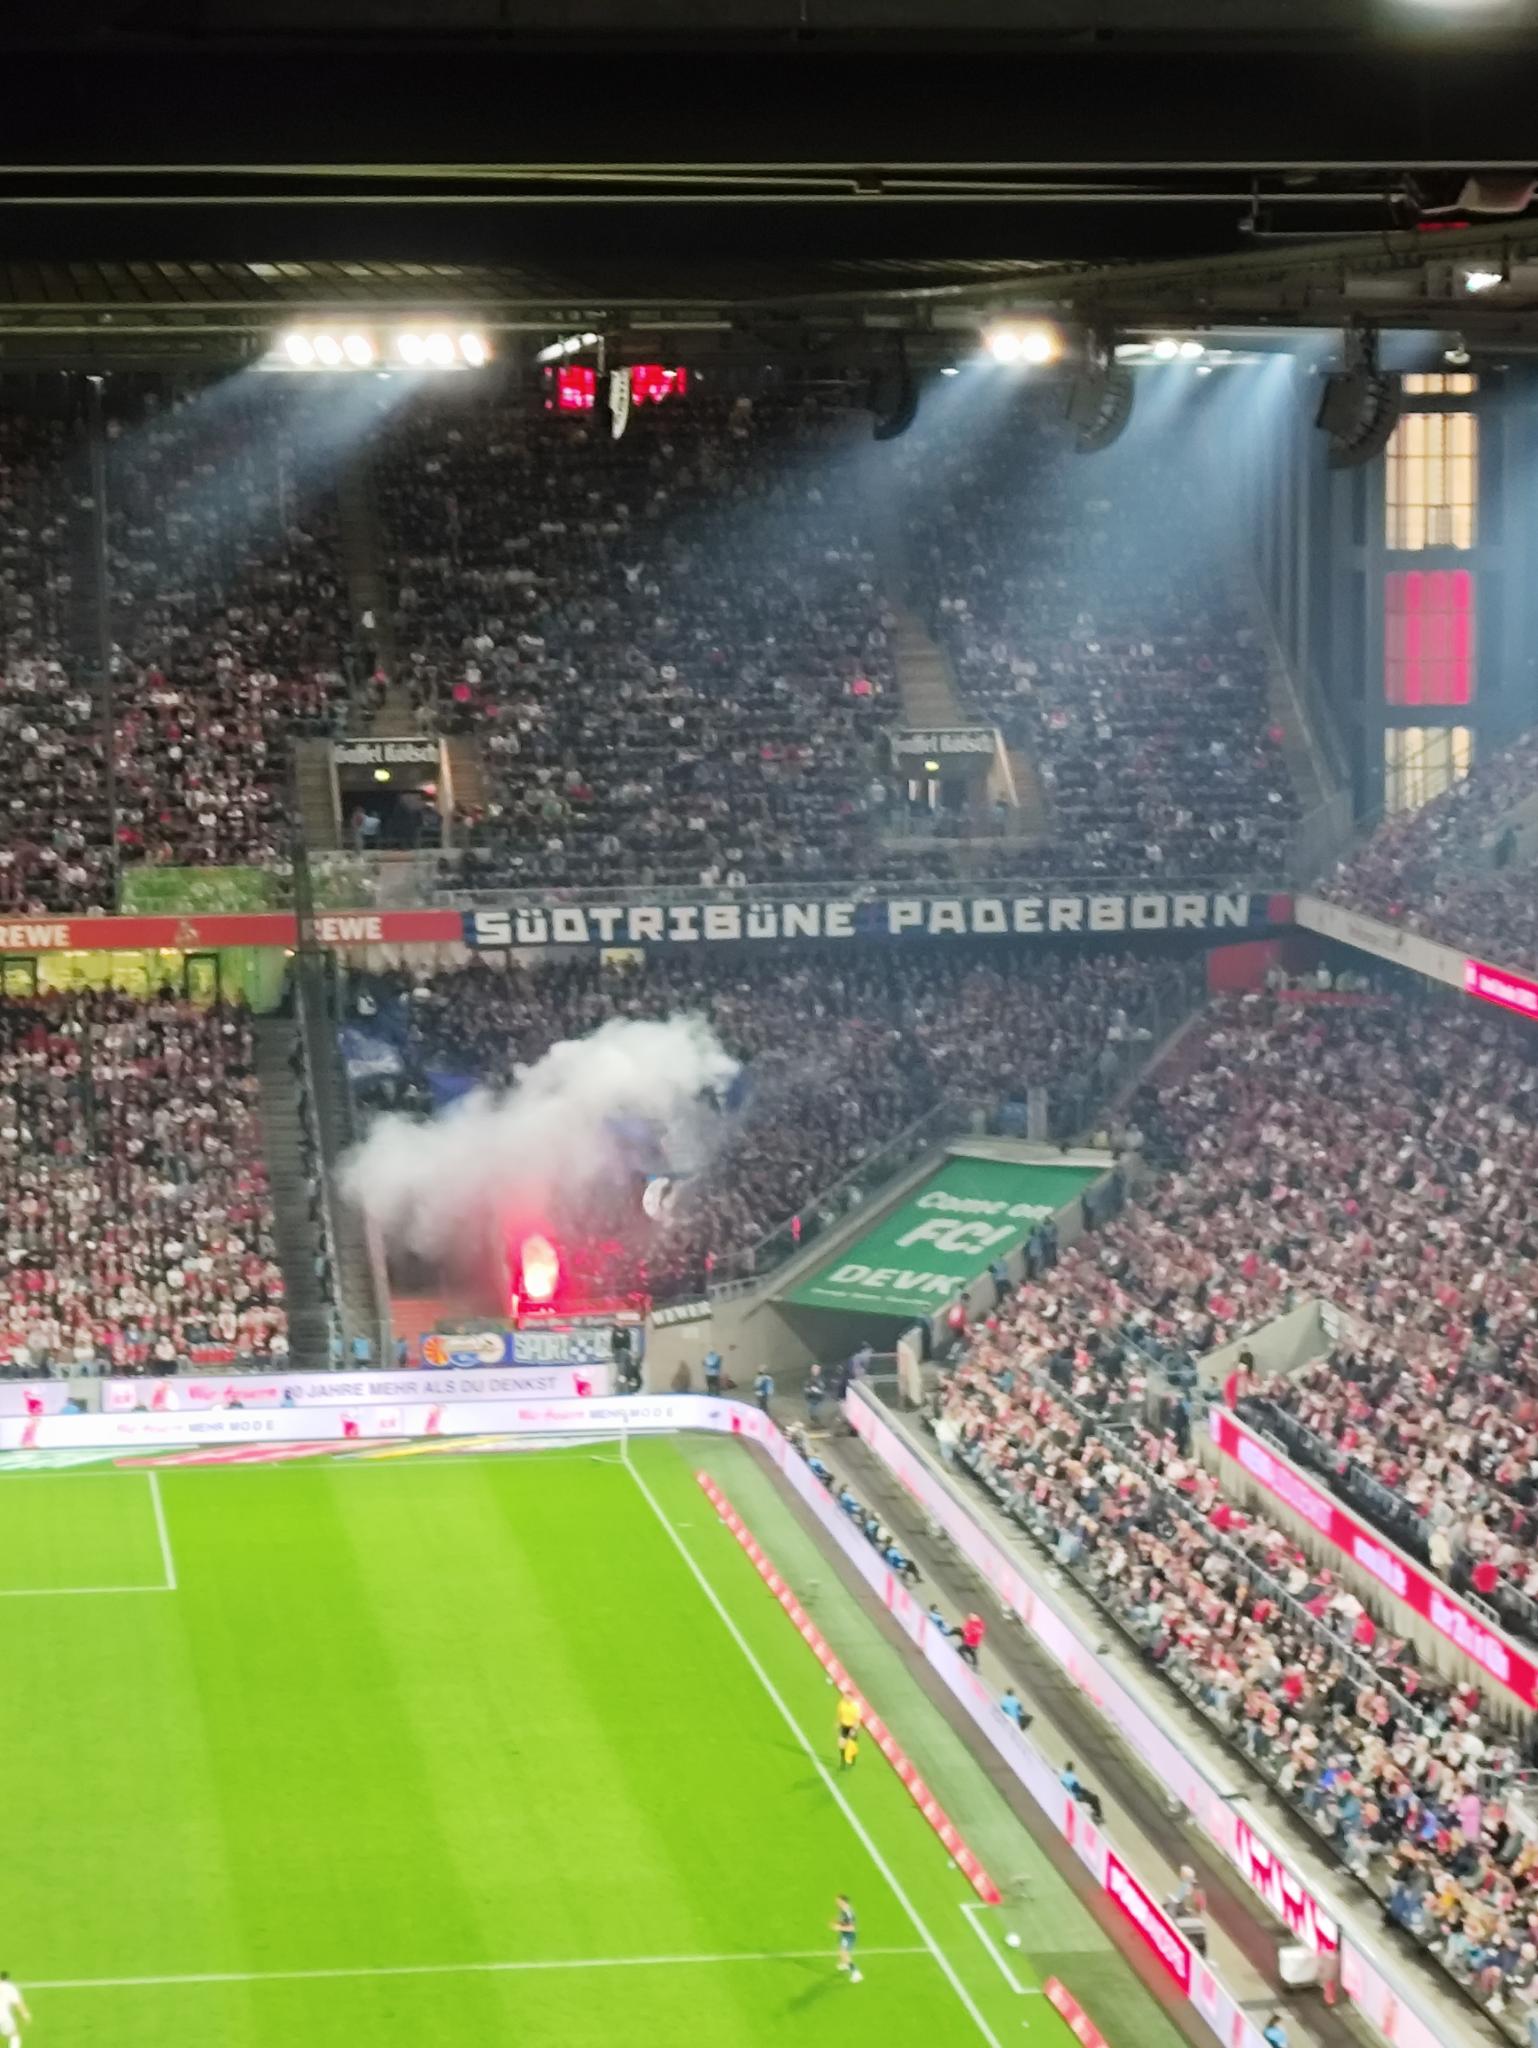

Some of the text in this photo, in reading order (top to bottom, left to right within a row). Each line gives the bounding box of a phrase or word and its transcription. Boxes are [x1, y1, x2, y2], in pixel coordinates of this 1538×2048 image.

[474, 896, 1250, 944] SÜDTRIBÜNE PADERBORN
[895, 1218, 1017, 1254] FC!
[828, 1264, 966, 1295] DEVK
[306, 1381, 364, 1398] JAHRE
[369, 1380, 418, 1396] MEHR
[423, 1378, 453, 1395] ALS
[460, 1377, 484, 1393] DU
[489, 1376, 556, 1392] DENKST
